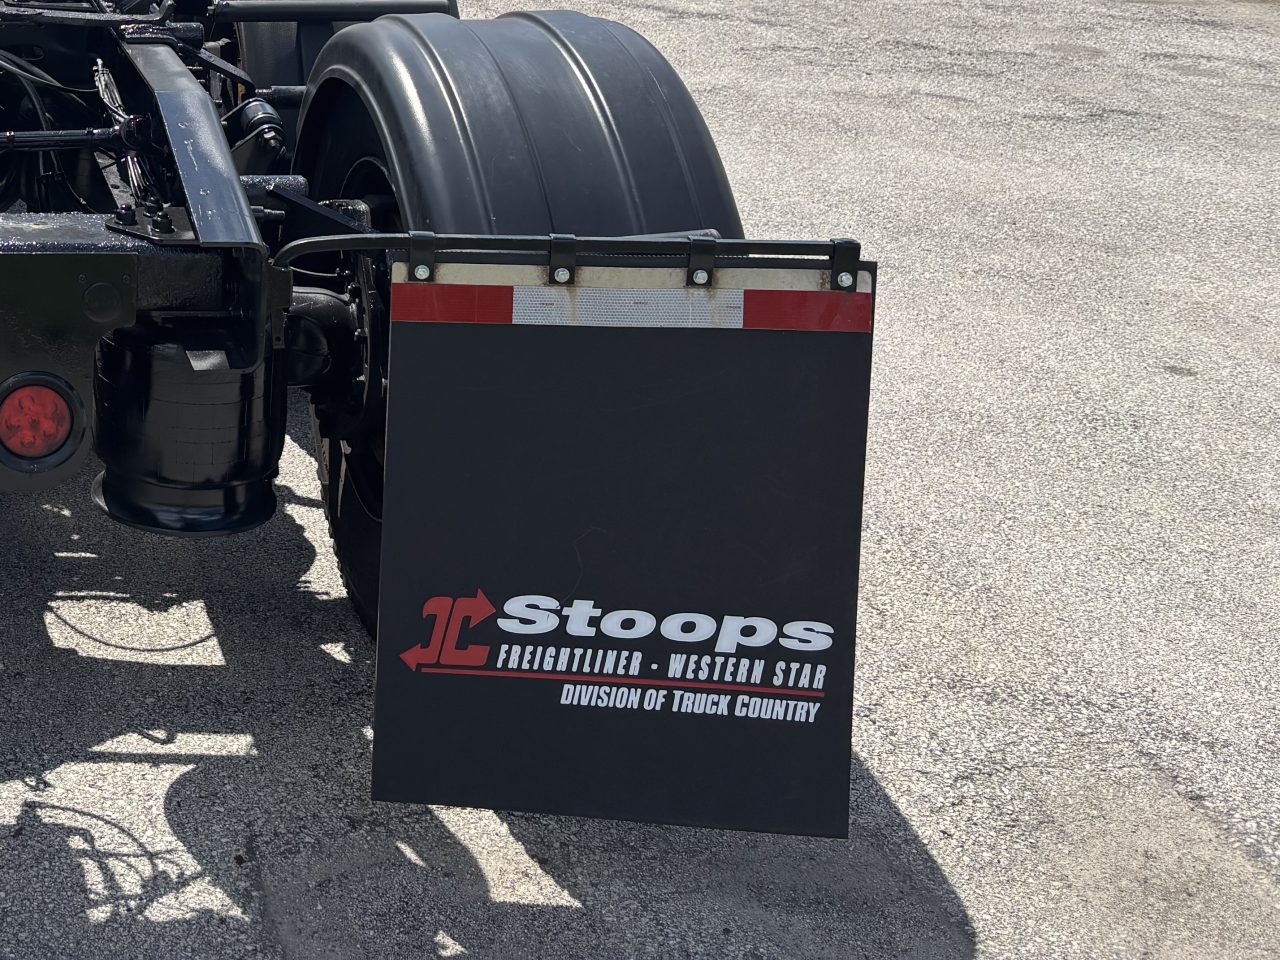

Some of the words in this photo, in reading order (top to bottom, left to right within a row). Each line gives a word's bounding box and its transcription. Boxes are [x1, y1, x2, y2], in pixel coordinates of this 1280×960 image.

[496, 594, 835, 654] Stoops
[496, 644, 643, 676] FREIGHTLINER
[667, 653, 765, 684] WESTERN
[772, 660, 827, 690] STAR
[560, 683, 642, 709] DIVISION
[643, 688, 668, 711] OF
[671, 689, 732, 716] TRUCK
[734, 694, 821, 723] COUNTRY
